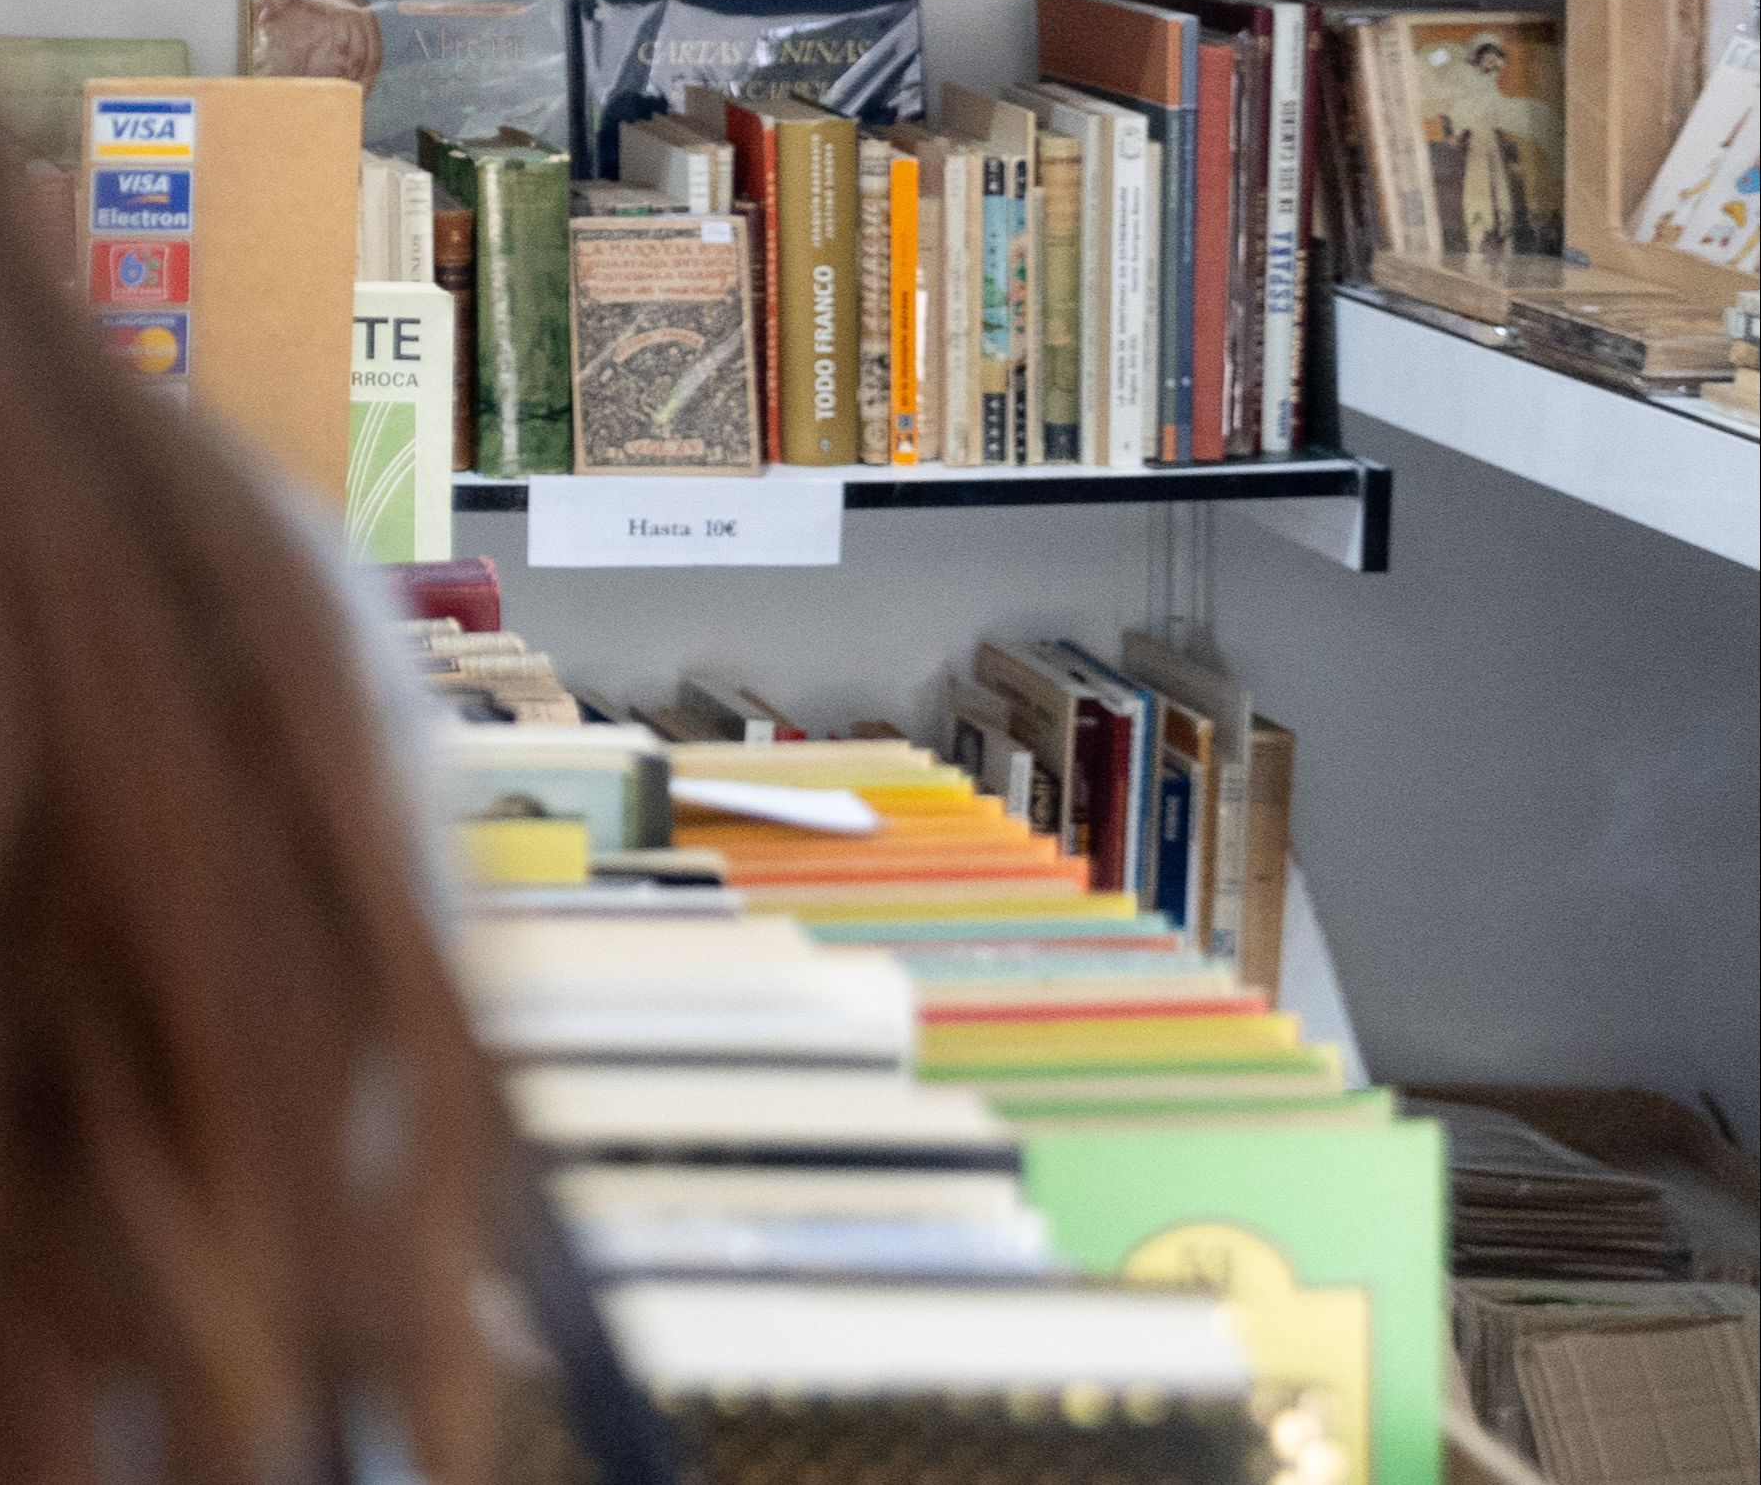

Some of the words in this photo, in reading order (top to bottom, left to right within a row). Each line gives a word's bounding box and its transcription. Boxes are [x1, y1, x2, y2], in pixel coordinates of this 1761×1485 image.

[639, 41, 745, 65] CARTAS
[112, 118, 176, 139] VISA
[118, 175, 169, 193] VISA
[98, 208, 187, 227] Electron
[814, 265, 835, 353] FRANCO
[815, 359, 836, 420] TODO
[628, 518, 691, 538] Hasta
[704, 518, 737, 539] 10€
